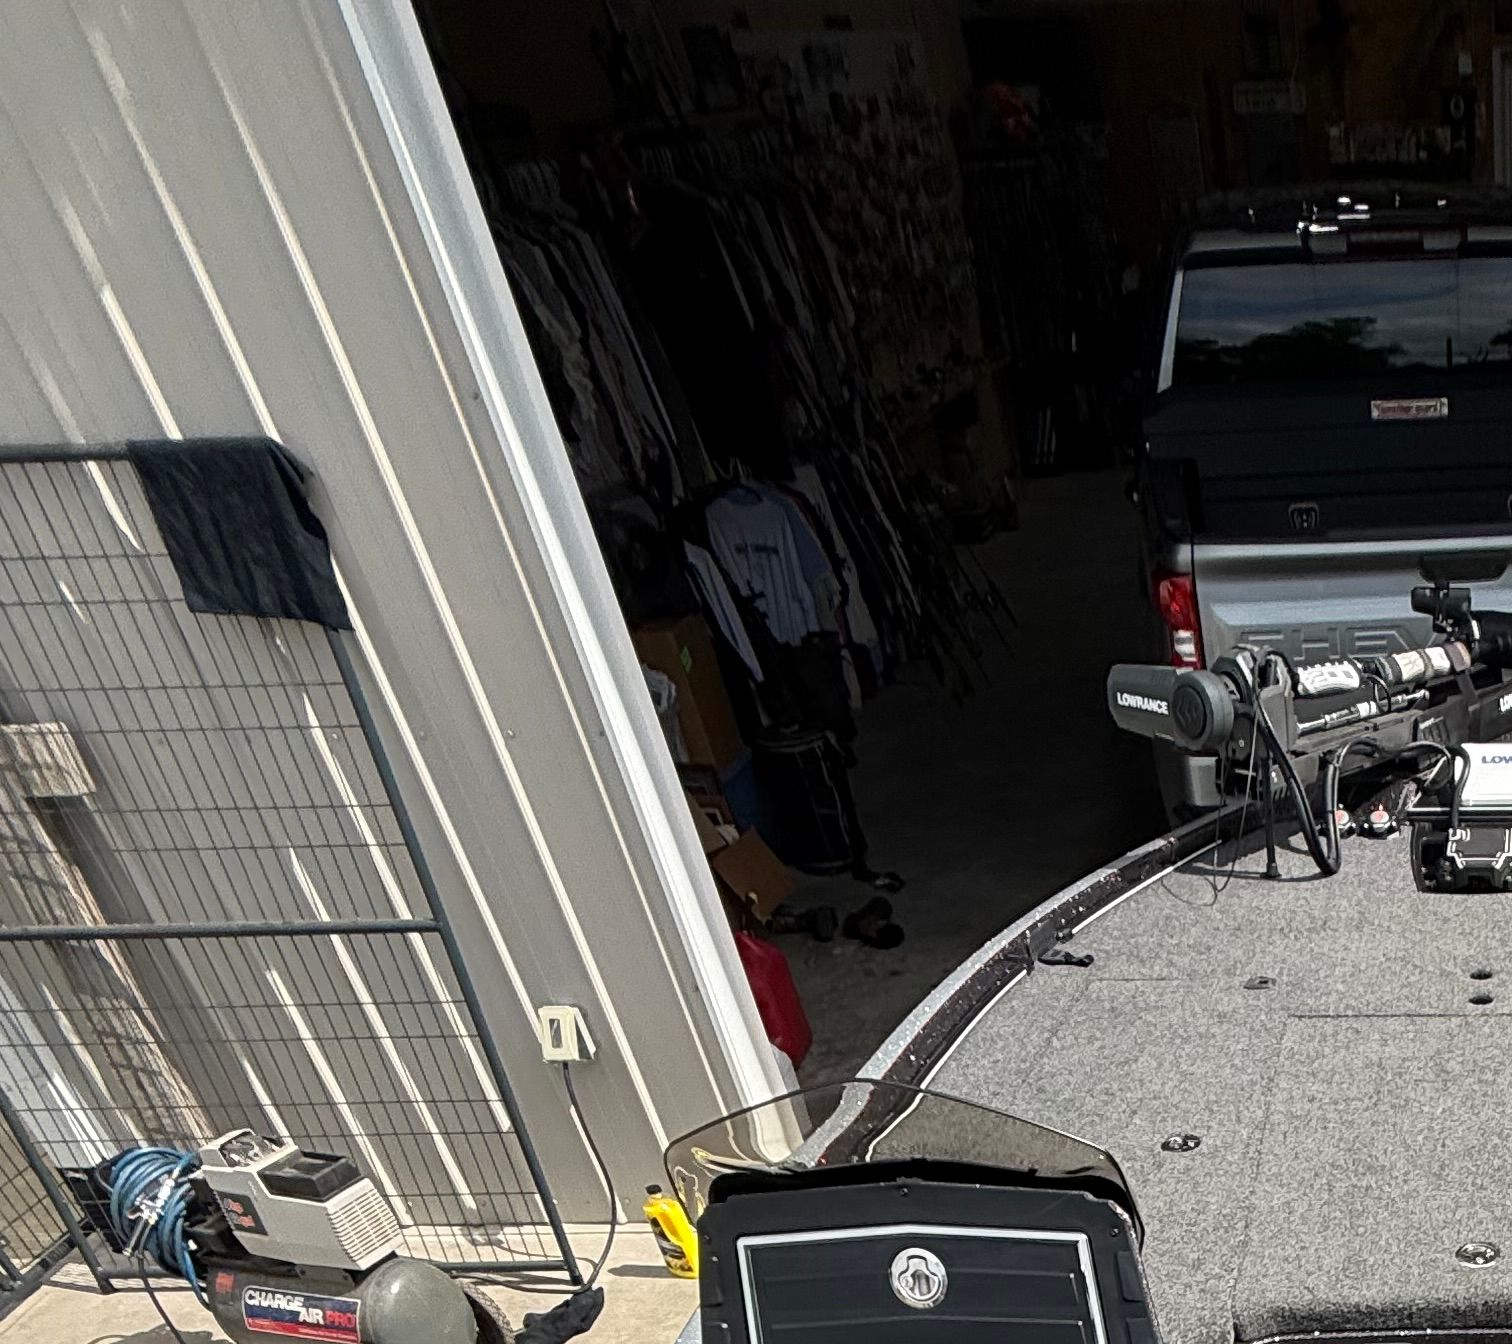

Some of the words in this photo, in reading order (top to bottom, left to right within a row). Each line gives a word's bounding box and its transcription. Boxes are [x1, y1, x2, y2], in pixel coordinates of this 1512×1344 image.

[1116, 691, 1169, 716] LOWRANCE
[244, 1289, 304, 1312] CHARGE
[299, 1306, 324, 1325] AIR
[325, 1310, 356, 1329] PRO
